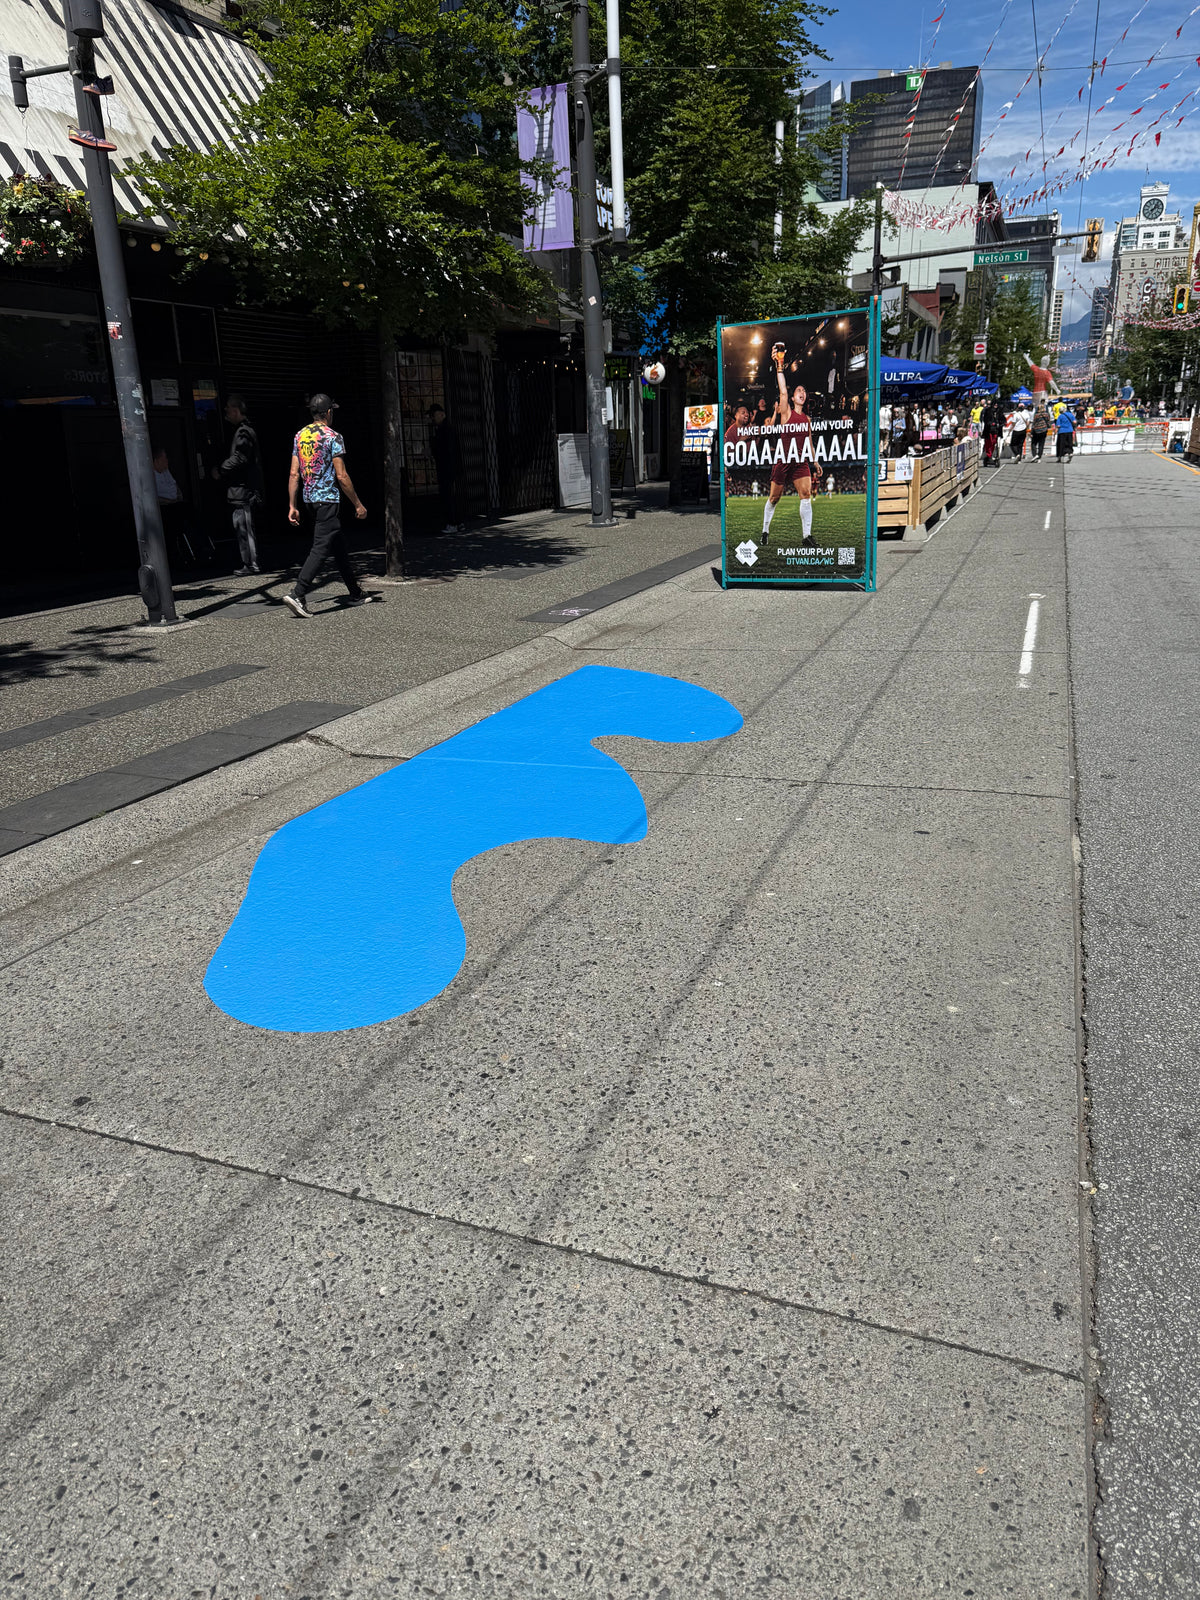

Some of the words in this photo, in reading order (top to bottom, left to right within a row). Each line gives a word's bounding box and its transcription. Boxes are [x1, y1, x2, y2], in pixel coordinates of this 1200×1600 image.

[908, 76, 922, 88] TD
[978, 254, 1010, 263] Nelson
[1013, 252, 1023, 261] St
[884, 372, 923, 382] ULTRA
[943, 375, 959, 384] TRA
[880, 385, 901, 393] TRA
[737, 426, 759, 436] MAKE
[760, 422, 808, 435] DOWNTOWN
[810, 421, 827, 431] VAN
[829, 419, 854, 430] YOUR
[723, 433, 868, 467] GOAAAAAAAAL
[777, 548, 795, 556] PLAN
[796, 548, 815, 556] YOUR
[816, 548, 835, 556] PLAY
[786, 557, 835, 566] DTVAN.CA/WC
